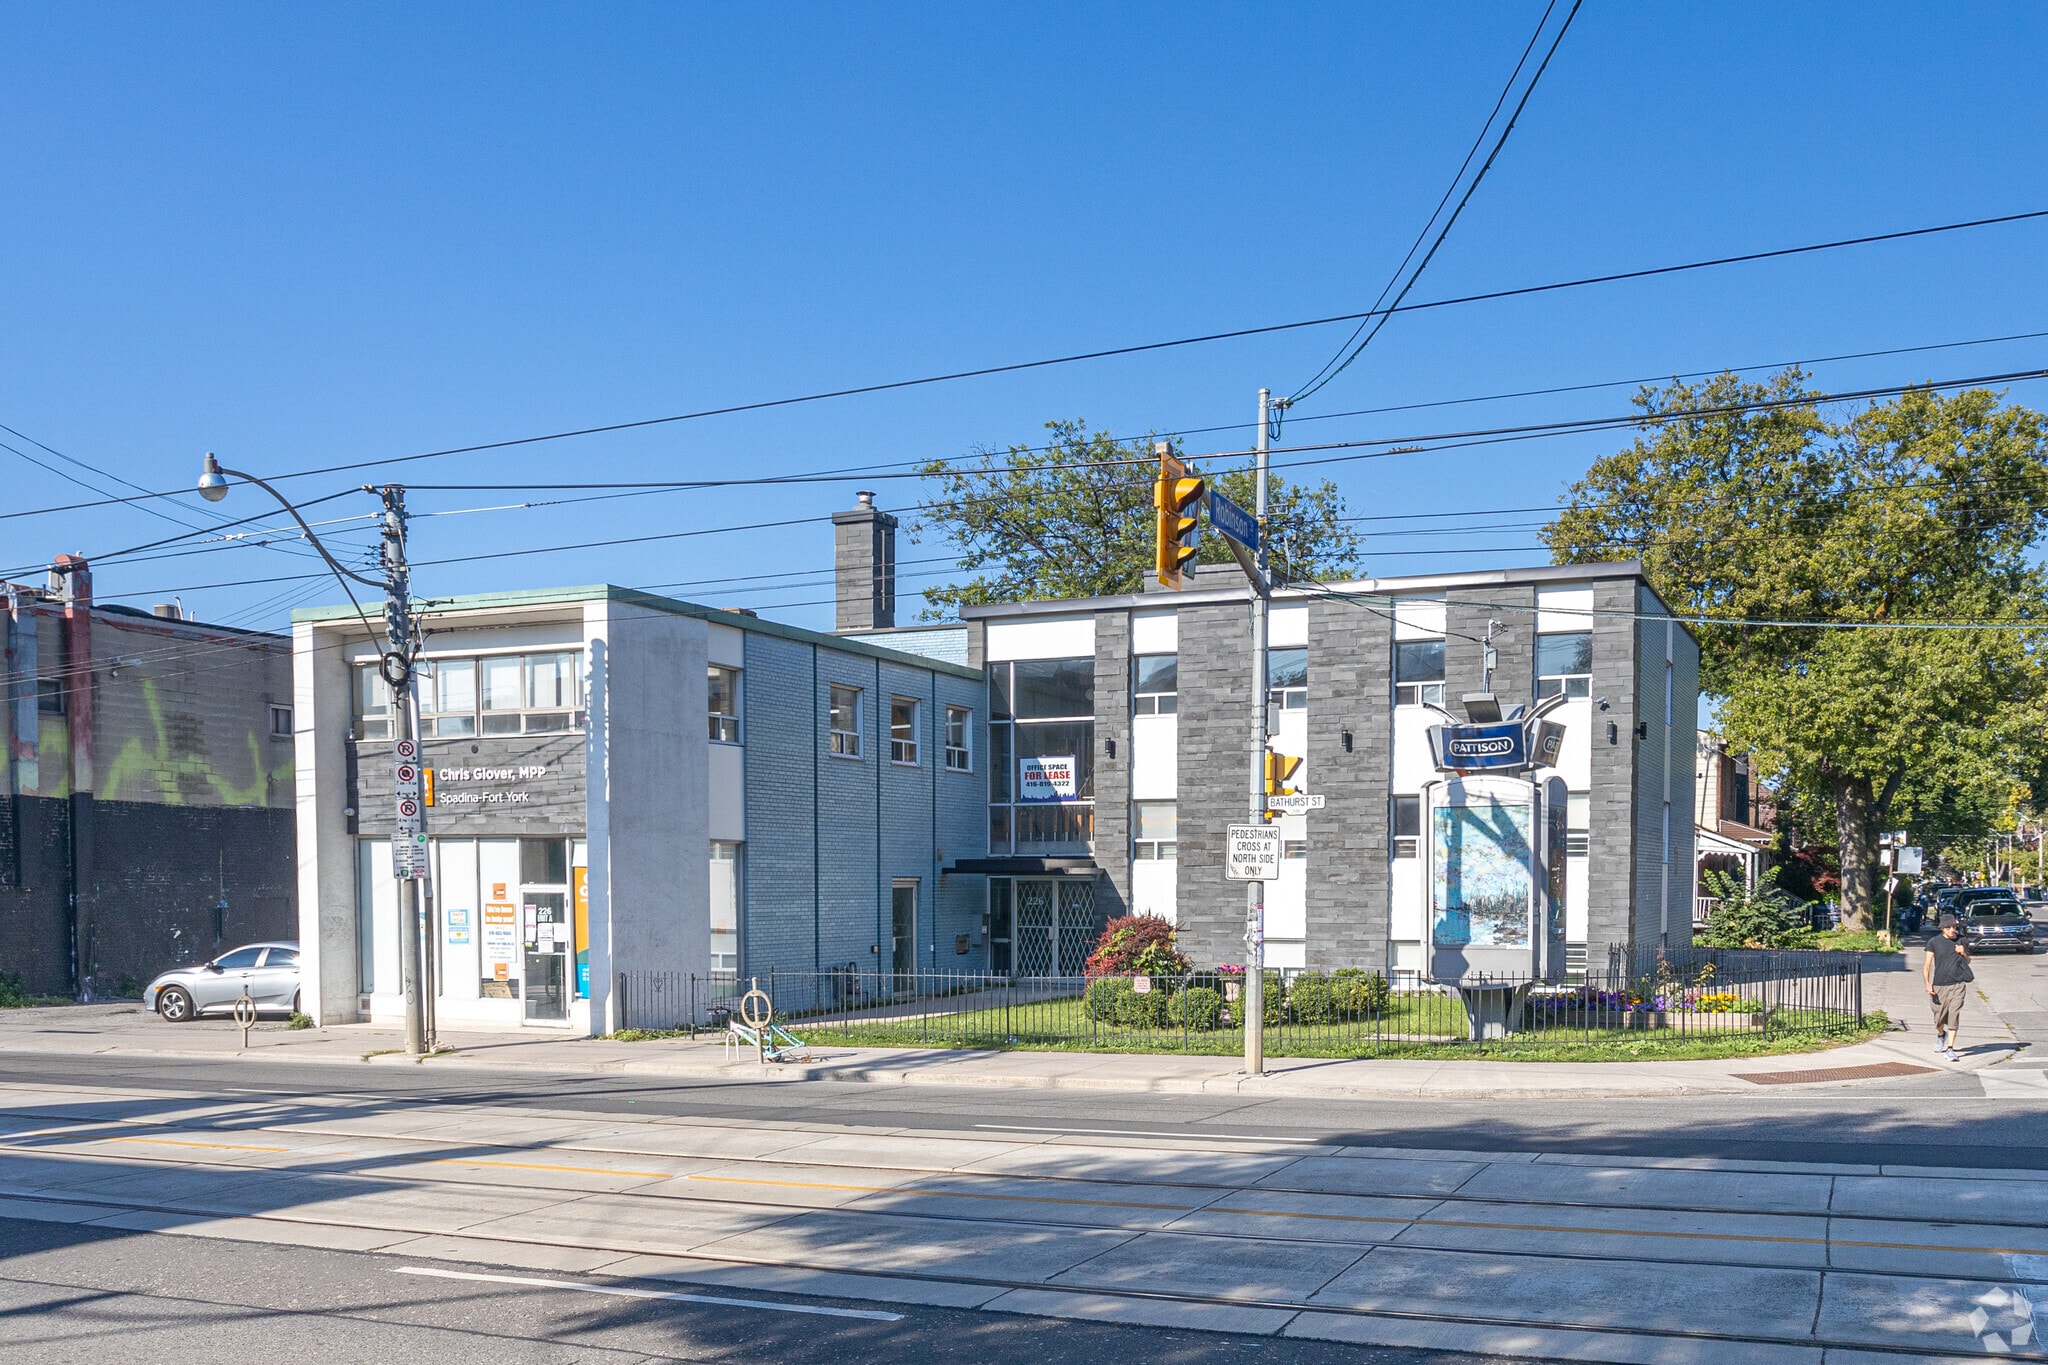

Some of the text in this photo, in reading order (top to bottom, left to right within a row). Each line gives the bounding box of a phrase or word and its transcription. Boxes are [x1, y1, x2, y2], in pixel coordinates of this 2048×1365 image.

[1215, 496, 1249, 539] Robinson
[1453, 740, 1508, 753] PATTISON
[439, 766, 547, 782] Chris Glover, MPP
[1024, 771, 1071, 780] FOR LEASE
[439, 791, 529, 805] Spadina-Fort York
[1270, 796, 1321, 807] BATHURST ST
[1230, 829, 1278, 840] PEDESTRIANS
[1236, 841, 1272, 852] CROSS AT
[1232, 853, 1275, 864] NORTH SIDE
[1244, 865, 1262, 876] ONLY
[1026, 896, 1044, 906] 226
[537, 907, 552, 915] 226
[548, 914, 553, 923] A
